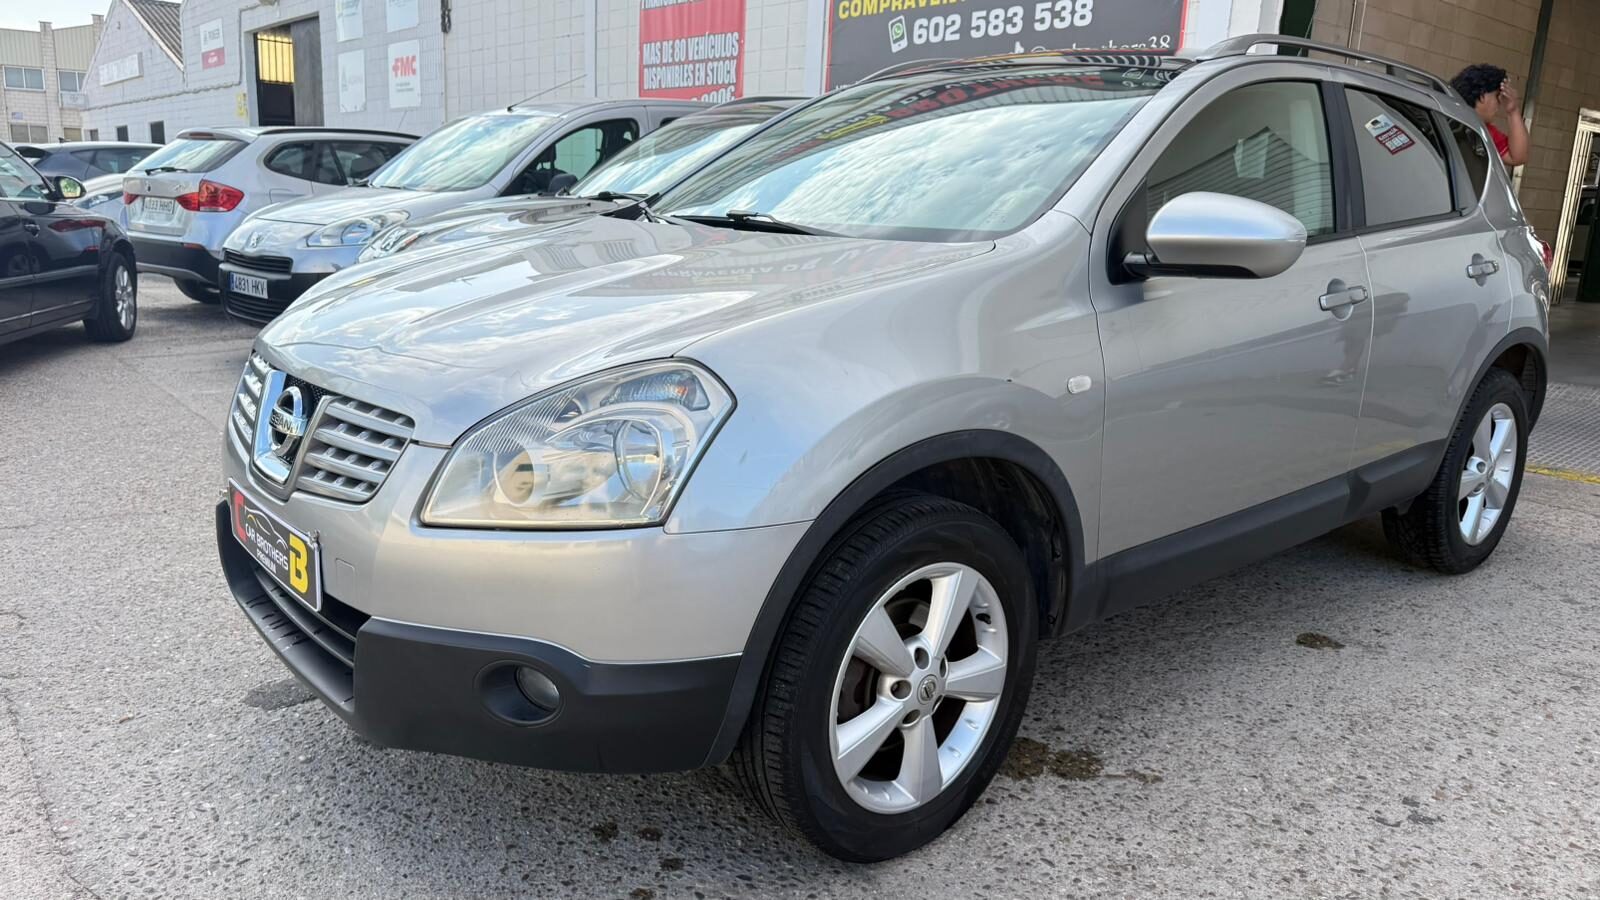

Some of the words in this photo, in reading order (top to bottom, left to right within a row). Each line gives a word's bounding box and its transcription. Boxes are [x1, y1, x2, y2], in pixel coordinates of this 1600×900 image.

[913, 14, 961, 45] 602
[970, 5, 1024, 38] 583
[1034, 0, 1094, 31] 538
[643, 42, 661, 65] MAS
[662, 40, 673, 63] DE
[674, 38, 686, 62] 80
[687, 31, 739, 60] VEHÍCULOS
[643, 64, 693, 90] DISPONIBLES
[695, 62, 706, 86] EN
[707, 59, 737, 85] STOCK
[235, 275, 250, 293] 4831
[251, 279, 265, 296] HKV
[245, 523, 257, 545] CAR
[256, 535, 289, 571] BROTHERS
[256, 548, 277, 574] PREMIUM
[289, 532, 309, 594] B
